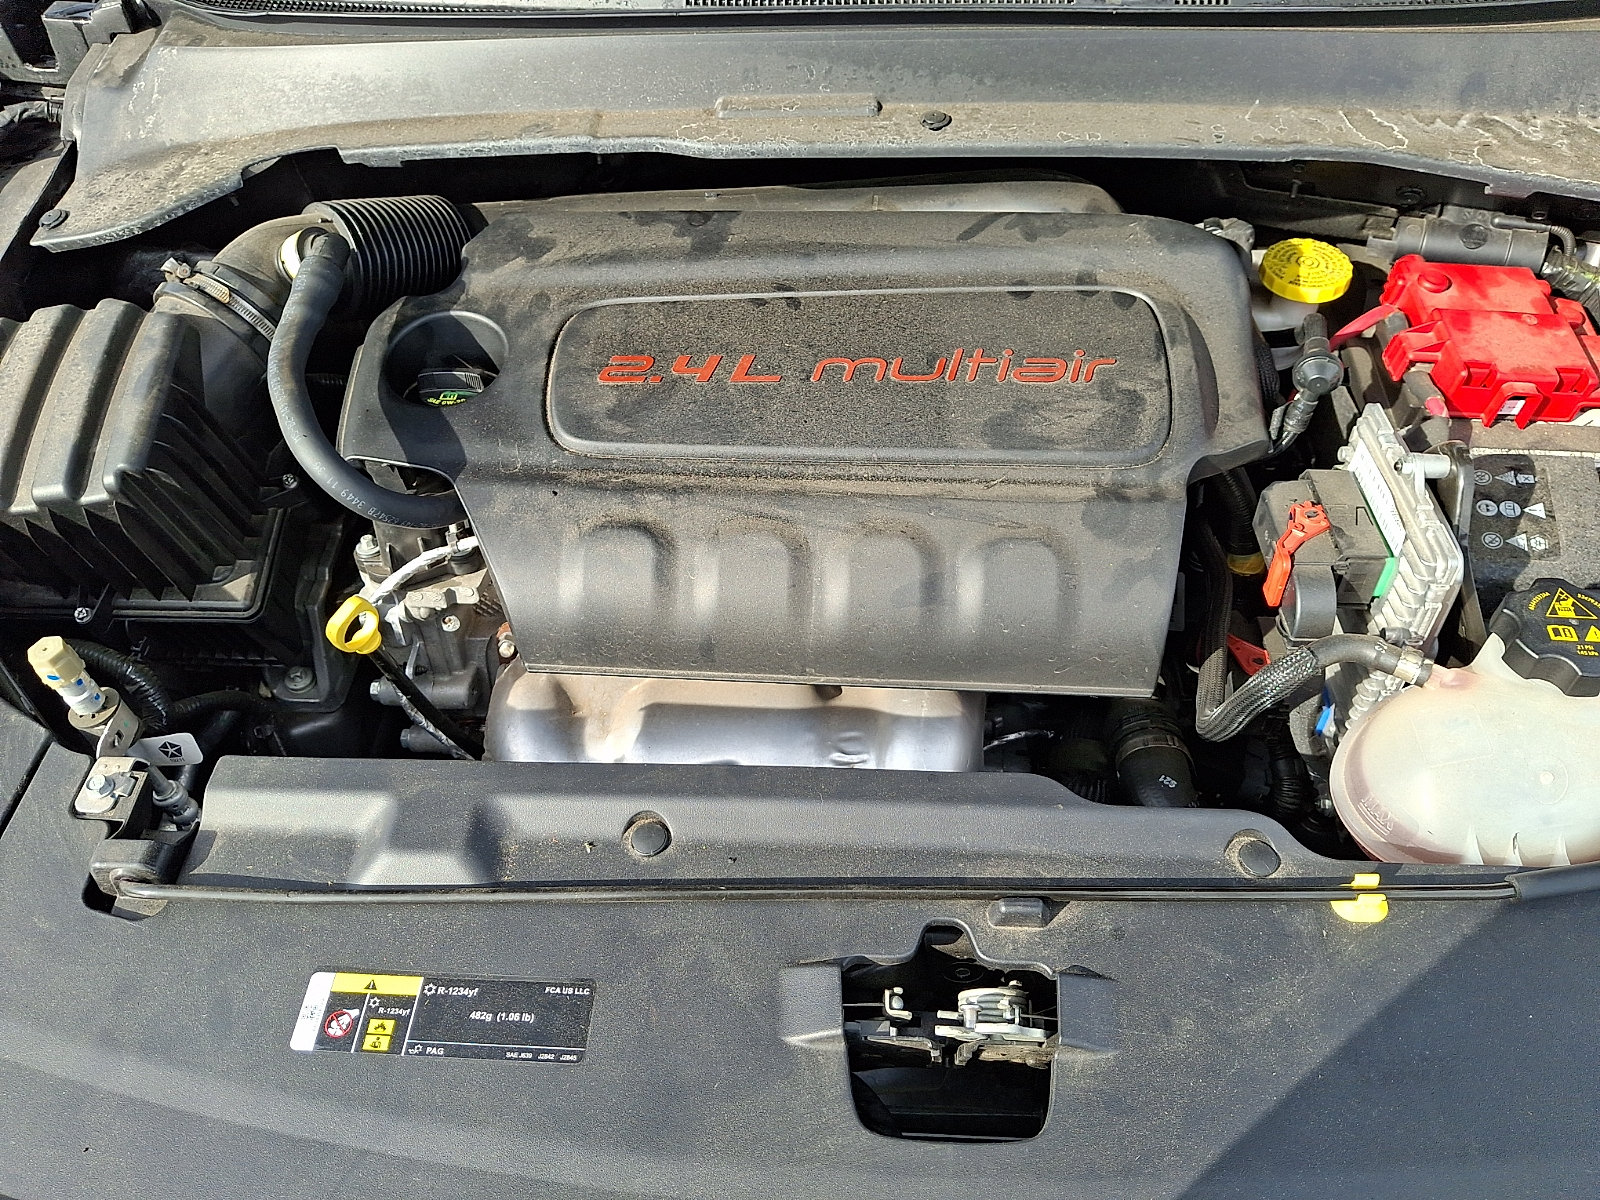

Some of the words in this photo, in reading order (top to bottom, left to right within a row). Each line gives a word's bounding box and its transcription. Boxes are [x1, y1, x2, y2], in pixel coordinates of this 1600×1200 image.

[811, 347, 1118, 384] multiair
[340, 488, 366, 509] 3449
[437, 985, 479, 998] R-1234yf
[544, 986, 561, 995] FCA
[562, 986, 574, 995] US
[574, 986, 591, 996] LLC
[377, 1006, 411, 1018] R-1234yf
[469, 1010, 493, 1022] 482g
[425, 1047, 445, 1056] PAG
[505, 1051, 518, 1059] SAE
